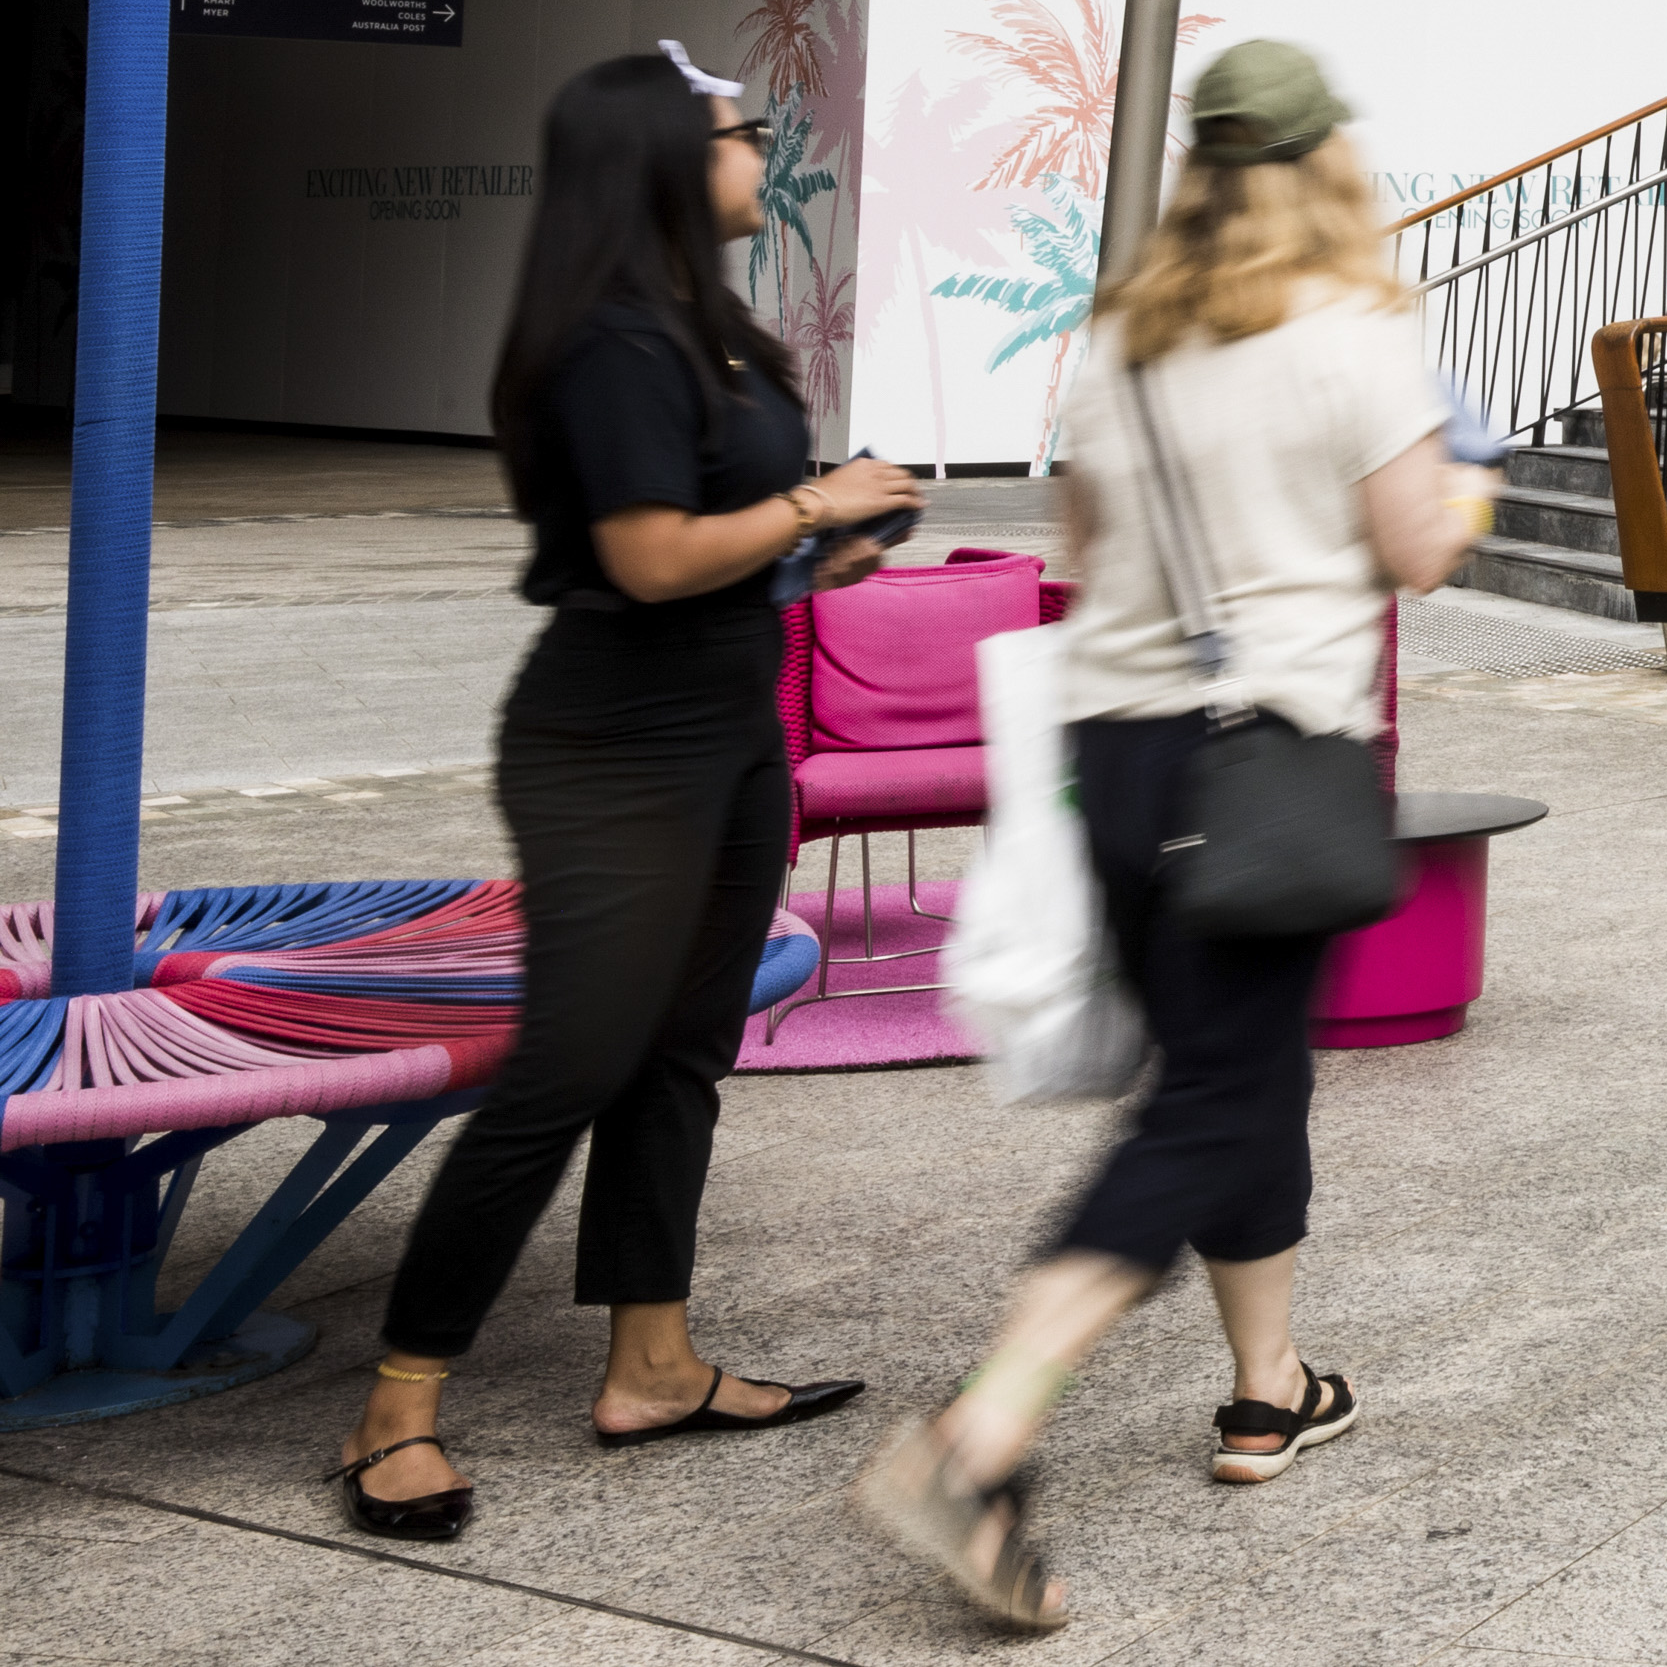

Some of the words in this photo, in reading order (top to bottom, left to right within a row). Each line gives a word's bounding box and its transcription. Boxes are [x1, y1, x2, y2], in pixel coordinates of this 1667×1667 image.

[361, 0, 427, 9] WOOLWORTHS
[203, 9, 229, 17] MYER
[397, 12, 426, 21] COLES
[352, 21, 400, 31] AUSTRALIA
[402, 23, 426, 32] POST
[306, 167, 388, 198] EXCITING
[392, 166, 437, 197] NEW
[441, 165, 533, 196] RETAILER
[369, 200, 423, 221] OPENING
[424, 199, 461, 221] SOON
[1401, 207, 1511, 230] OENING
